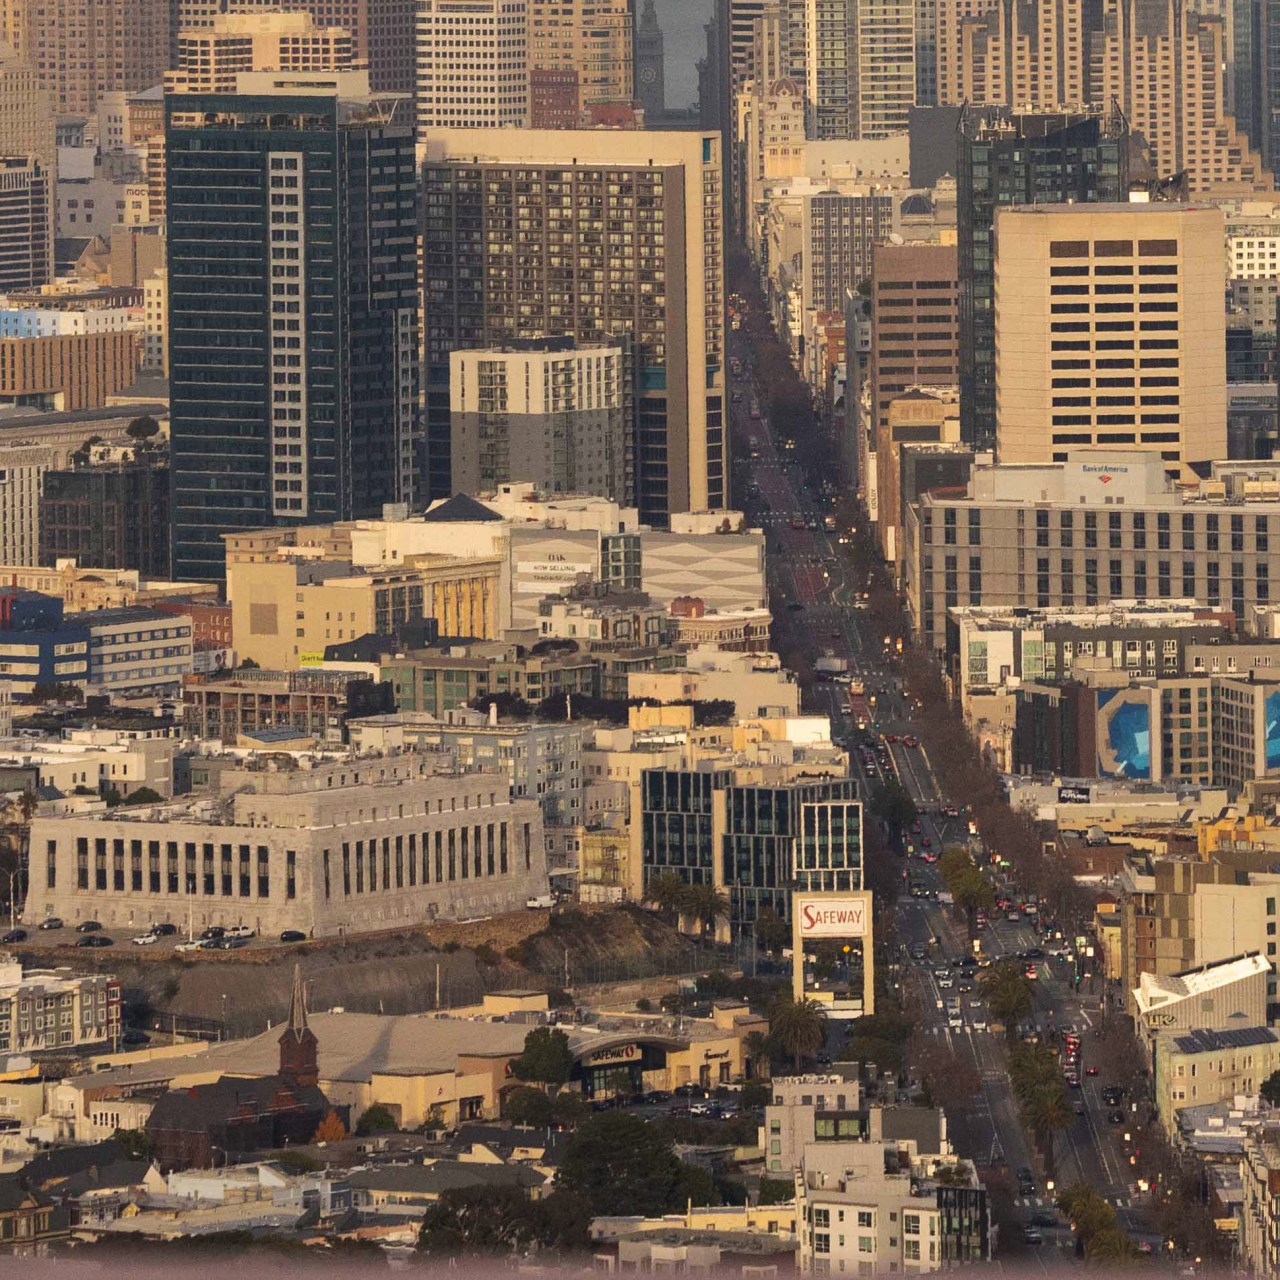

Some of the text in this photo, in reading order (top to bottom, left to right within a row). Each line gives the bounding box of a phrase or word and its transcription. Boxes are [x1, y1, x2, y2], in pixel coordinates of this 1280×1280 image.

[1082, 464, 1097, 472] Bank
[1104, 465, 1128, 473] America
[592, 1049, 625, 1061] SAFEWAY
